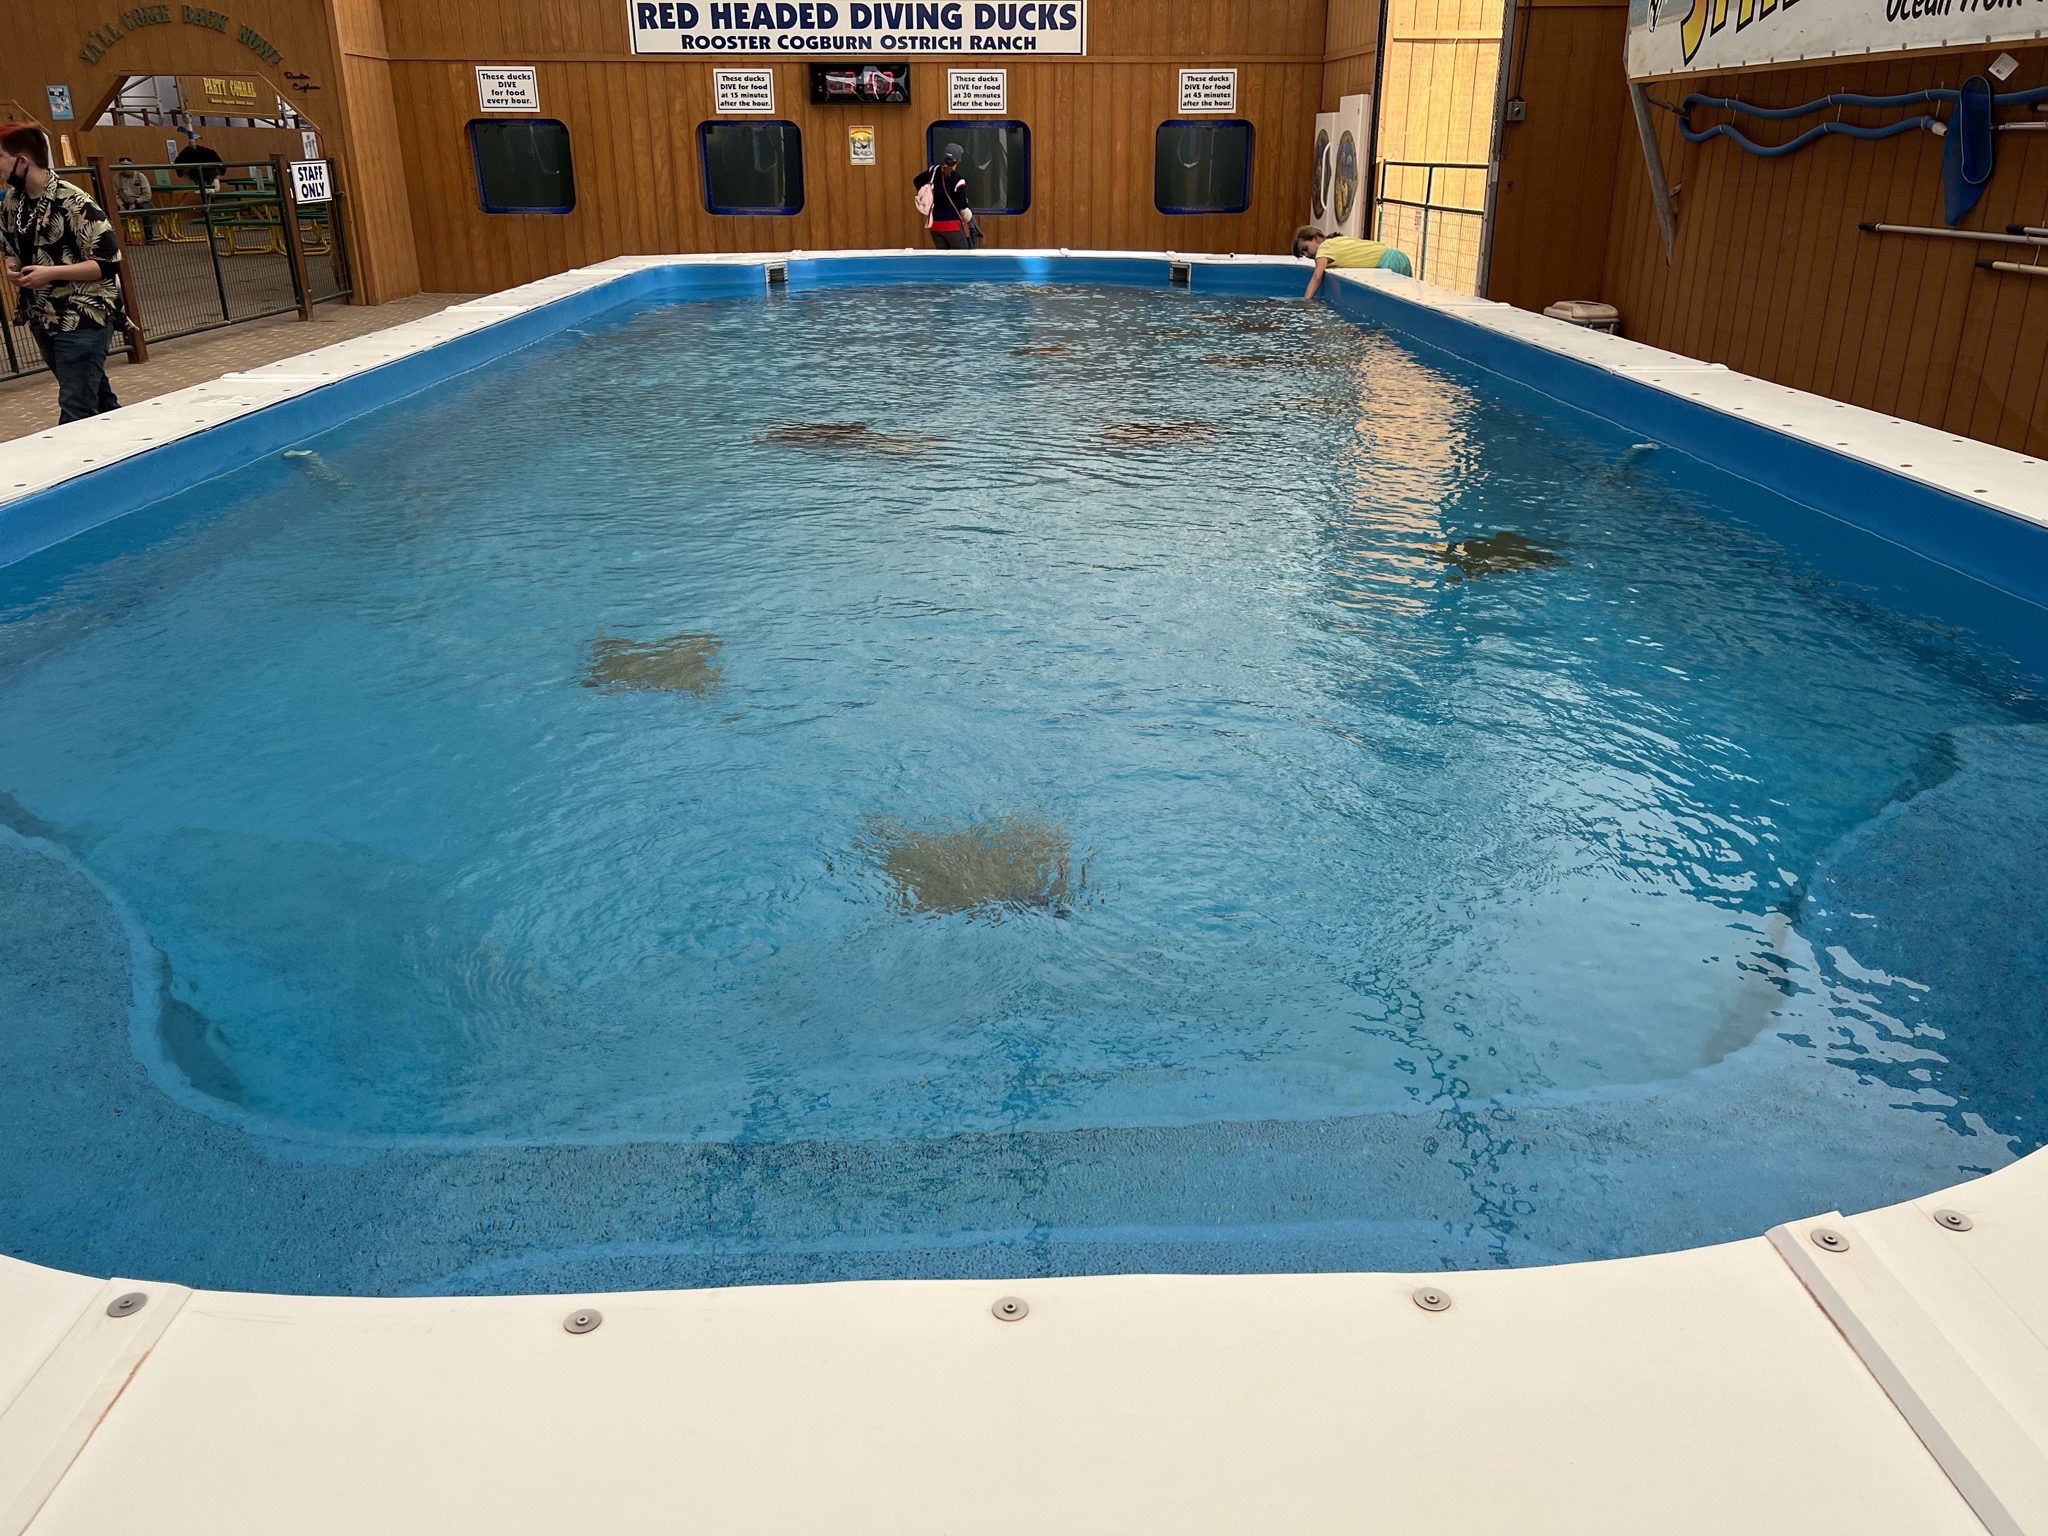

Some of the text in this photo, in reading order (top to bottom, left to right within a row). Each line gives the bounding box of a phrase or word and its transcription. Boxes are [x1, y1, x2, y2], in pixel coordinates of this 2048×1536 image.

[637, 2, 1077, 31] RED HEADED DIVING DUCKS
[121, 4, 173, 31] COME
[181, 4, 230, 34] BACK
[236, 22, 284, 68] NOW!
[681, 34, 1037, 50] ROOSTER COGBURN OSTRICH RANCH
[202, 77, 257, 98] PARTY CORRAL
[297, 165, 323, 182] STAFF
[301, 182, 325, 199] ONLY
